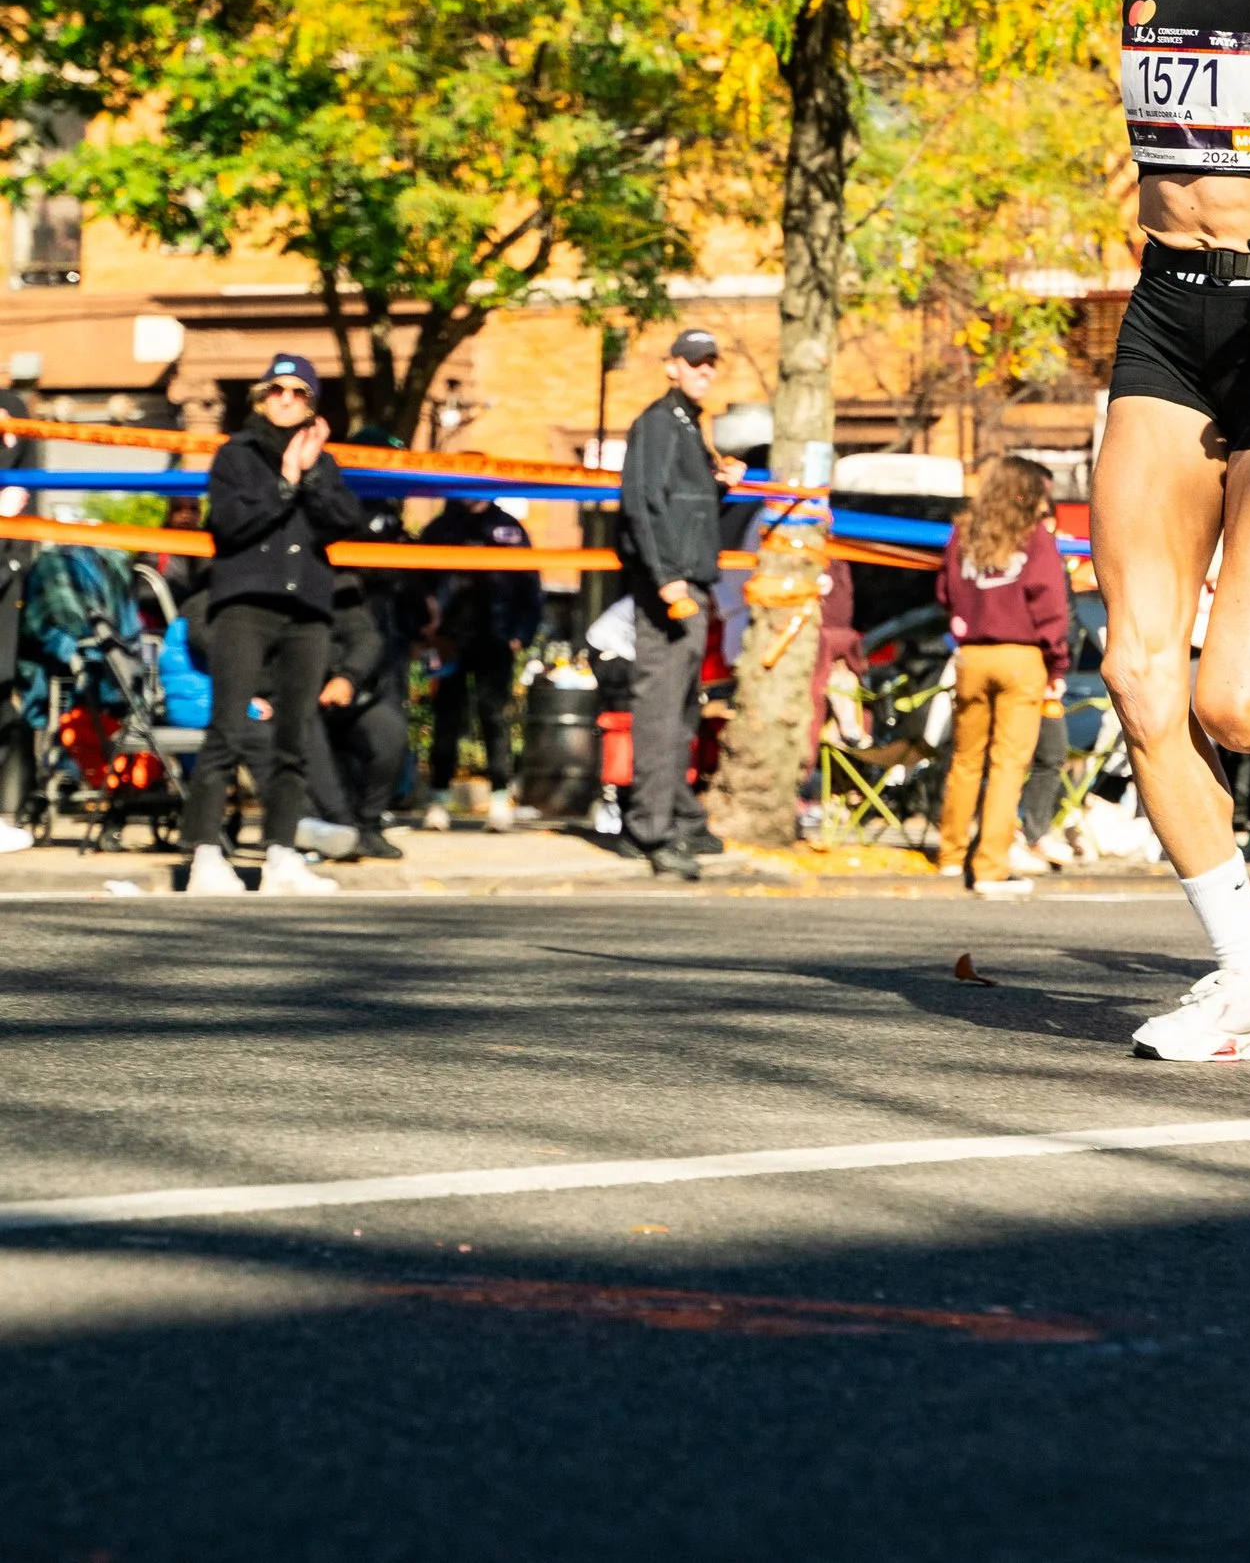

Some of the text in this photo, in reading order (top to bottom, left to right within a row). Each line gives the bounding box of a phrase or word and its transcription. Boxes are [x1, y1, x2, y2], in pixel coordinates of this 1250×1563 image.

[1157, 27, 1200, 37] CONSULTANCY
[1157, 35, 1184, 44] SERVICES
[1138, 56, 1219, 107] 1571
[1138, 107, 1144, 118] 1
[1184, 109, 1193, 120] A
[1201, 151, 1240, 164] 2024
